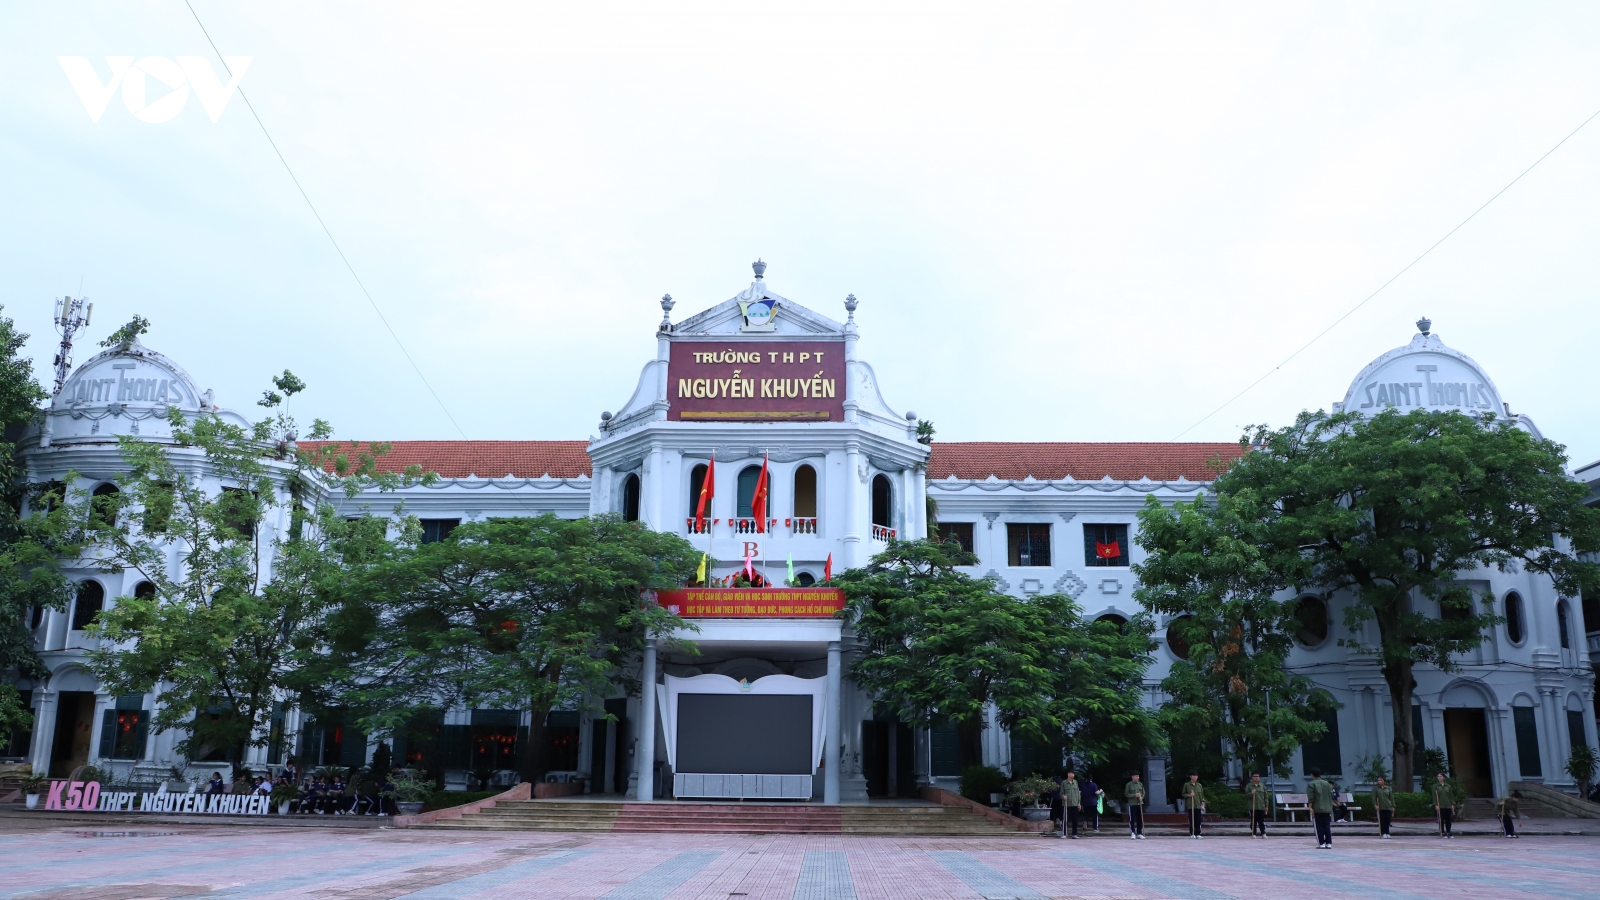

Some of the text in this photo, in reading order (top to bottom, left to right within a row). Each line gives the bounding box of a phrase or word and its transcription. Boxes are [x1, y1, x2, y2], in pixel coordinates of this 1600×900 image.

[693, 349, 761, 364] TRƯỜNG
[65, 363, 183, 404] SAINT THOMAS
[678, 369, 836, 398] NGUYỄN KHUYẾN
[1361, 365, 1492, 409] SAINT THOMAS
[742, 541, 759, 558] B
[45, 780, 101, 811] K50
[100, 792, 137, 811] THPT
